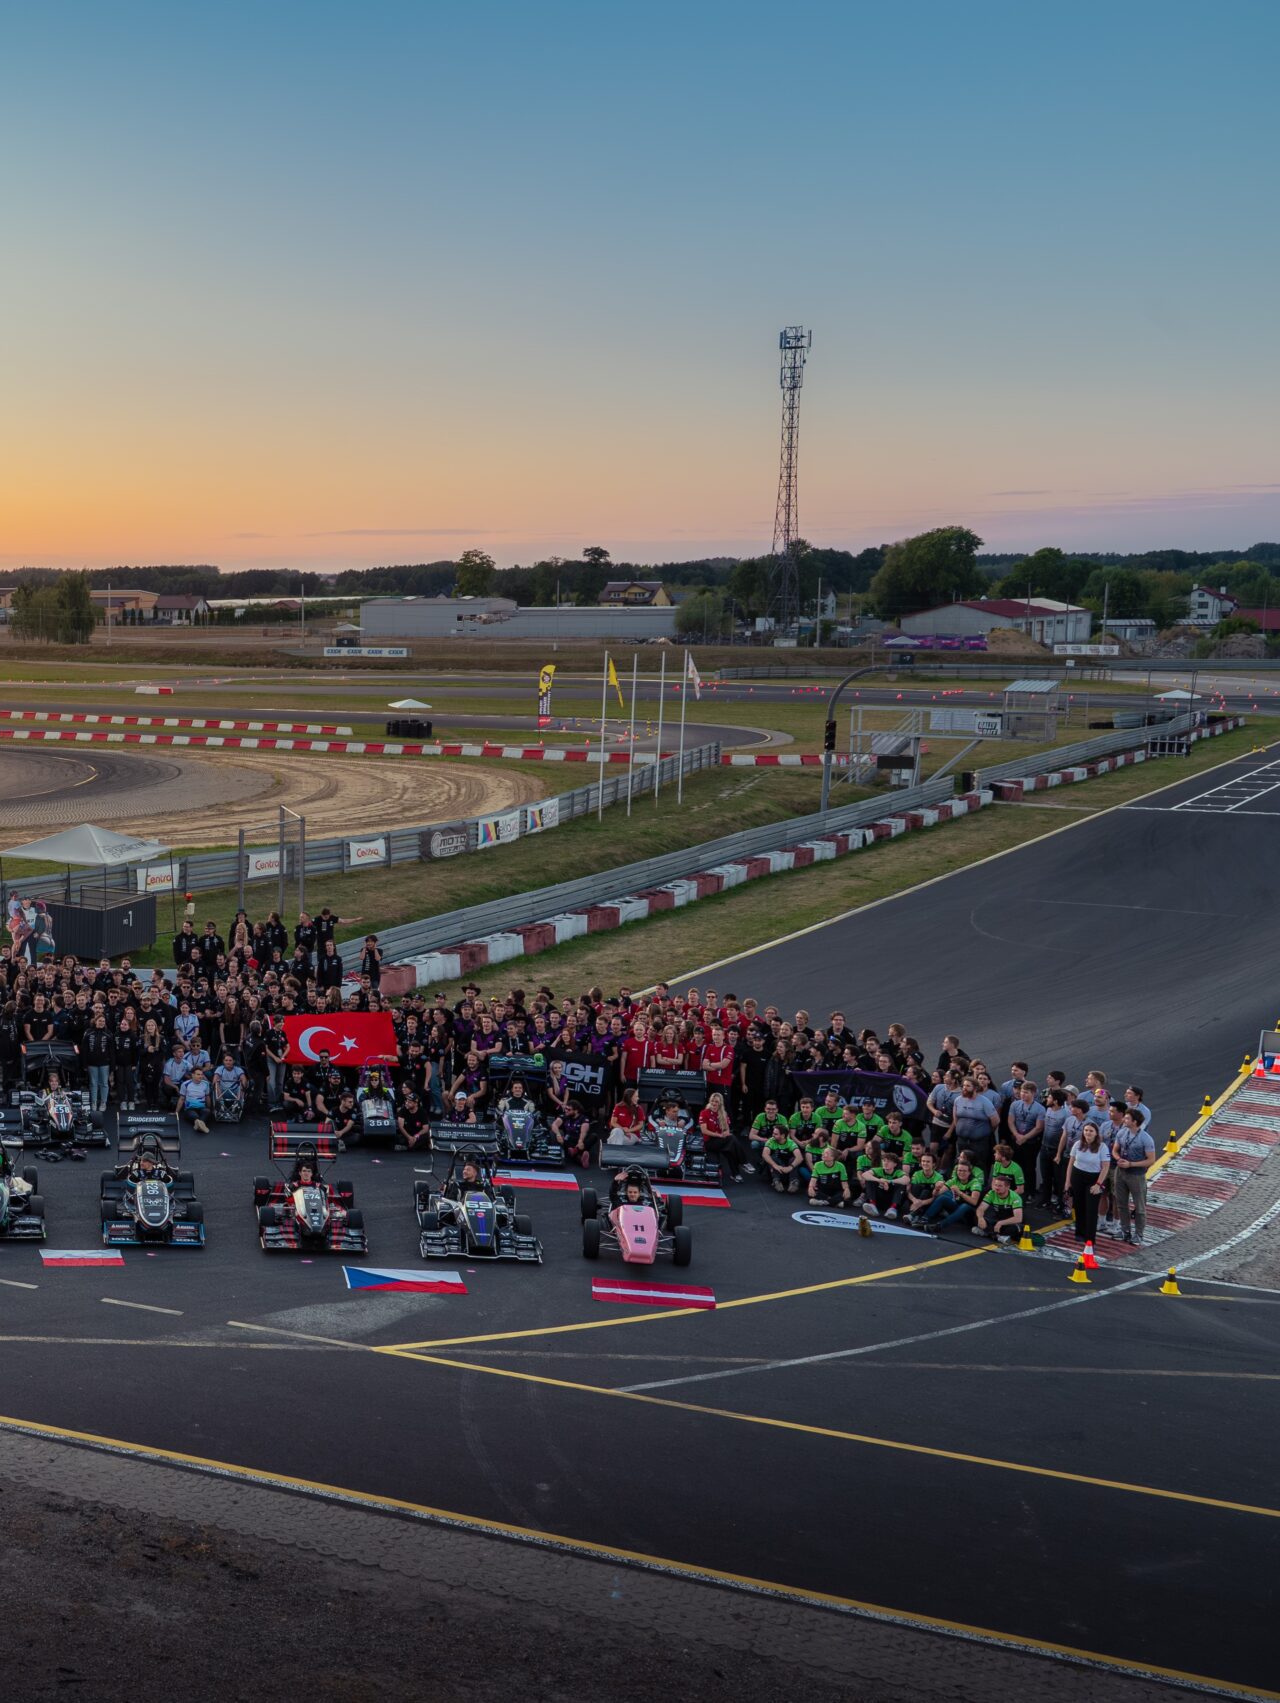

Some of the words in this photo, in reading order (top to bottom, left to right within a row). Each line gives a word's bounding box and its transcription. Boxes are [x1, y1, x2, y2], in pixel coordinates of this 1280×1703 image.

[440, 835, 467, 847] MOTO
[816, 1084, 841, 1095] FS
[369, 1119, 391, 1127] 350
[465, 1201, 493, 1209] 69
